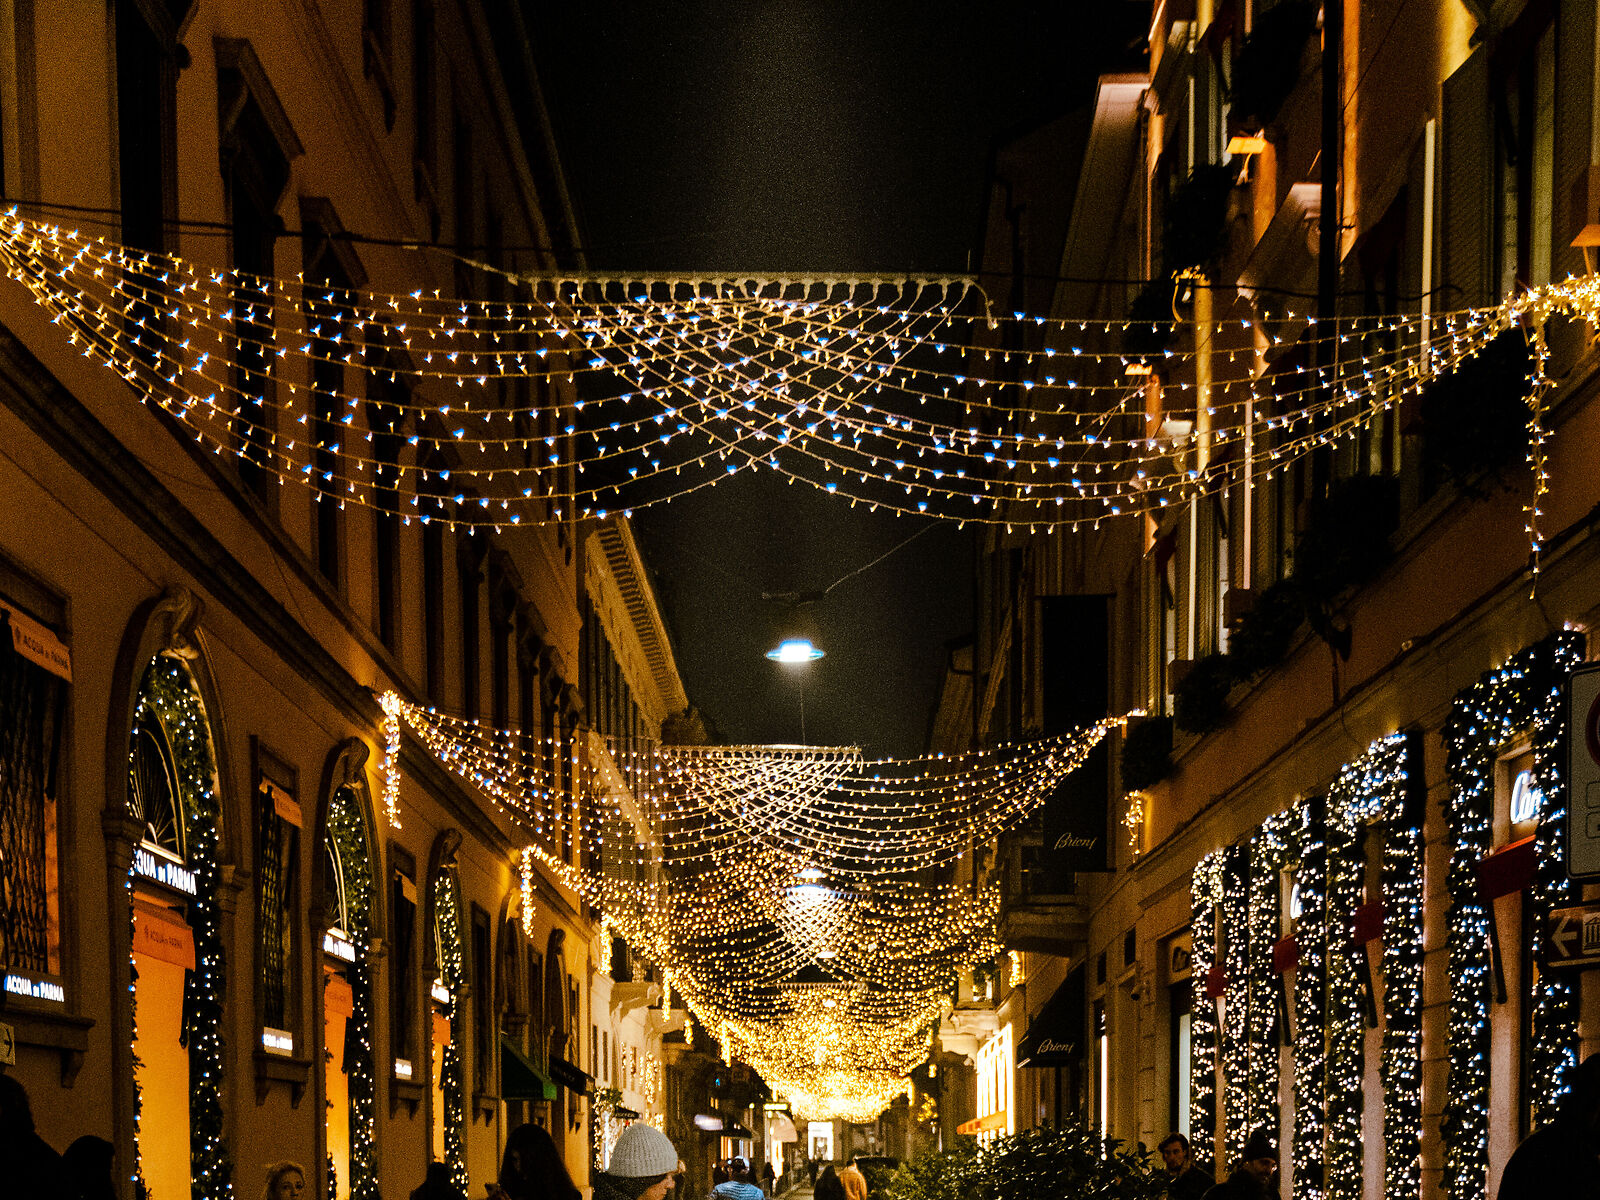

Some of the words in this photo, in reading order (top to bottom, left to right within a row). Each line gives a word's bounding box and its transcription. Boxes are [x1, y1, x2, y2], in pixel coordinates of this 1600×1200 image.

[166, 863, 197, 896] PARMA
[6, 975, 32, 996] ACQUA
[40, 981, 65, 1002] PARMA
